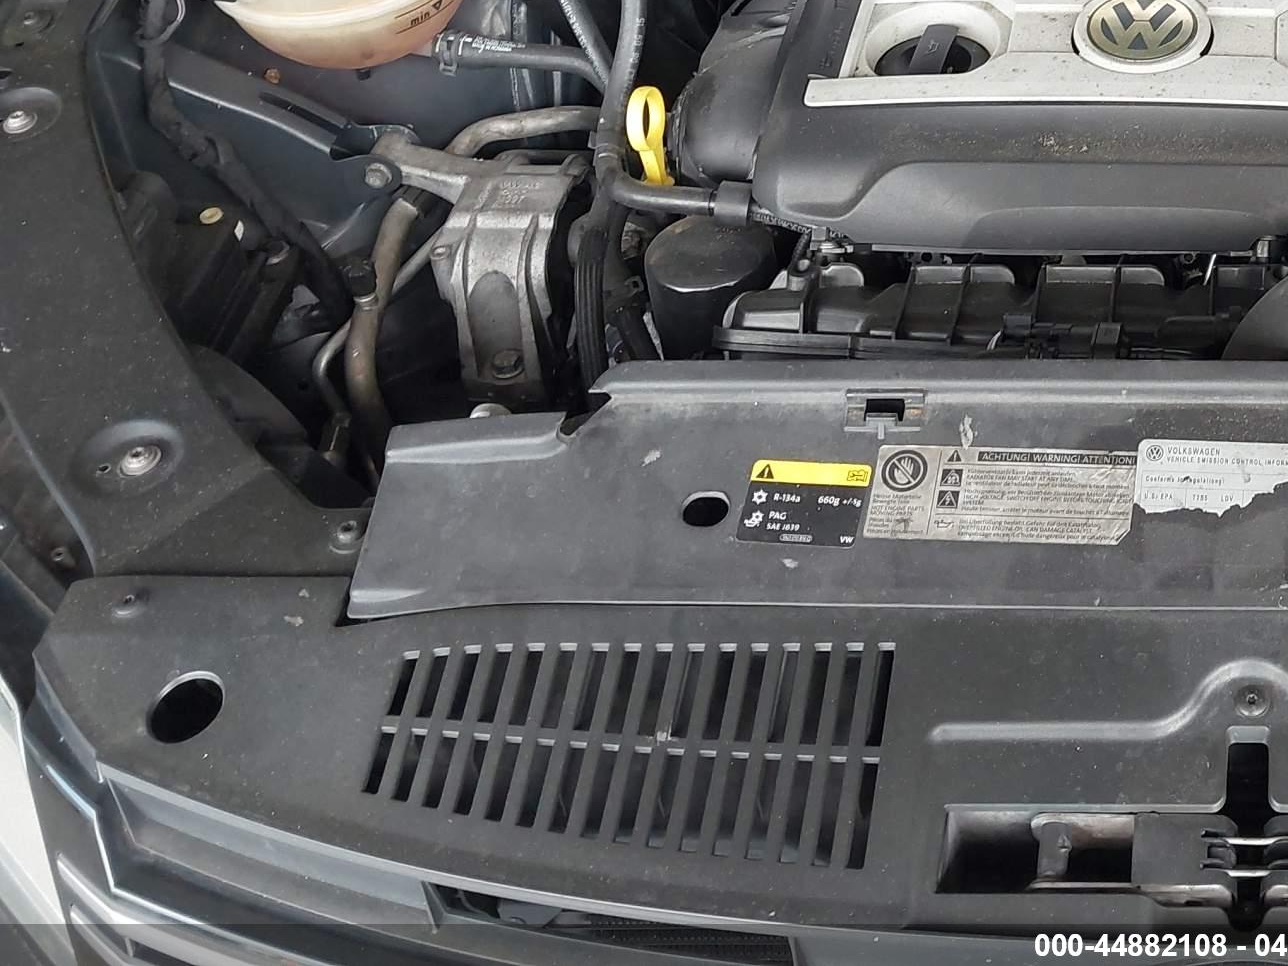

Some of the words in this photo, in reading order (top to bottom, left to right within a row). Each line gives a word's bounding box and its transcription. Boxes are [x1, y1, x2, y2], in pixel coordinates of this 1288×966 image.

[410, 11, 430, 26] min
[1167, 446, 1221, 456] VOLKSWAGEN
[982, 452, 1030, 461] ACHTUNG!
[1033, 453, 1080, 463] WARNING!
[1167, 456, 1194, 464] VEHICLE
[1145, 475, 1174, 483] Conforms
[1186, 477, 1225, 488] egulations:
[773, 493, 801, 503] R-134a
[818, 495, 840, 507] 660g
[1160, 492, 1173, 500] EPA
[768, 511, 787, 521] PAG
[766, 522, 781, 531] SAE
[840, 535, 855, 545] VW
